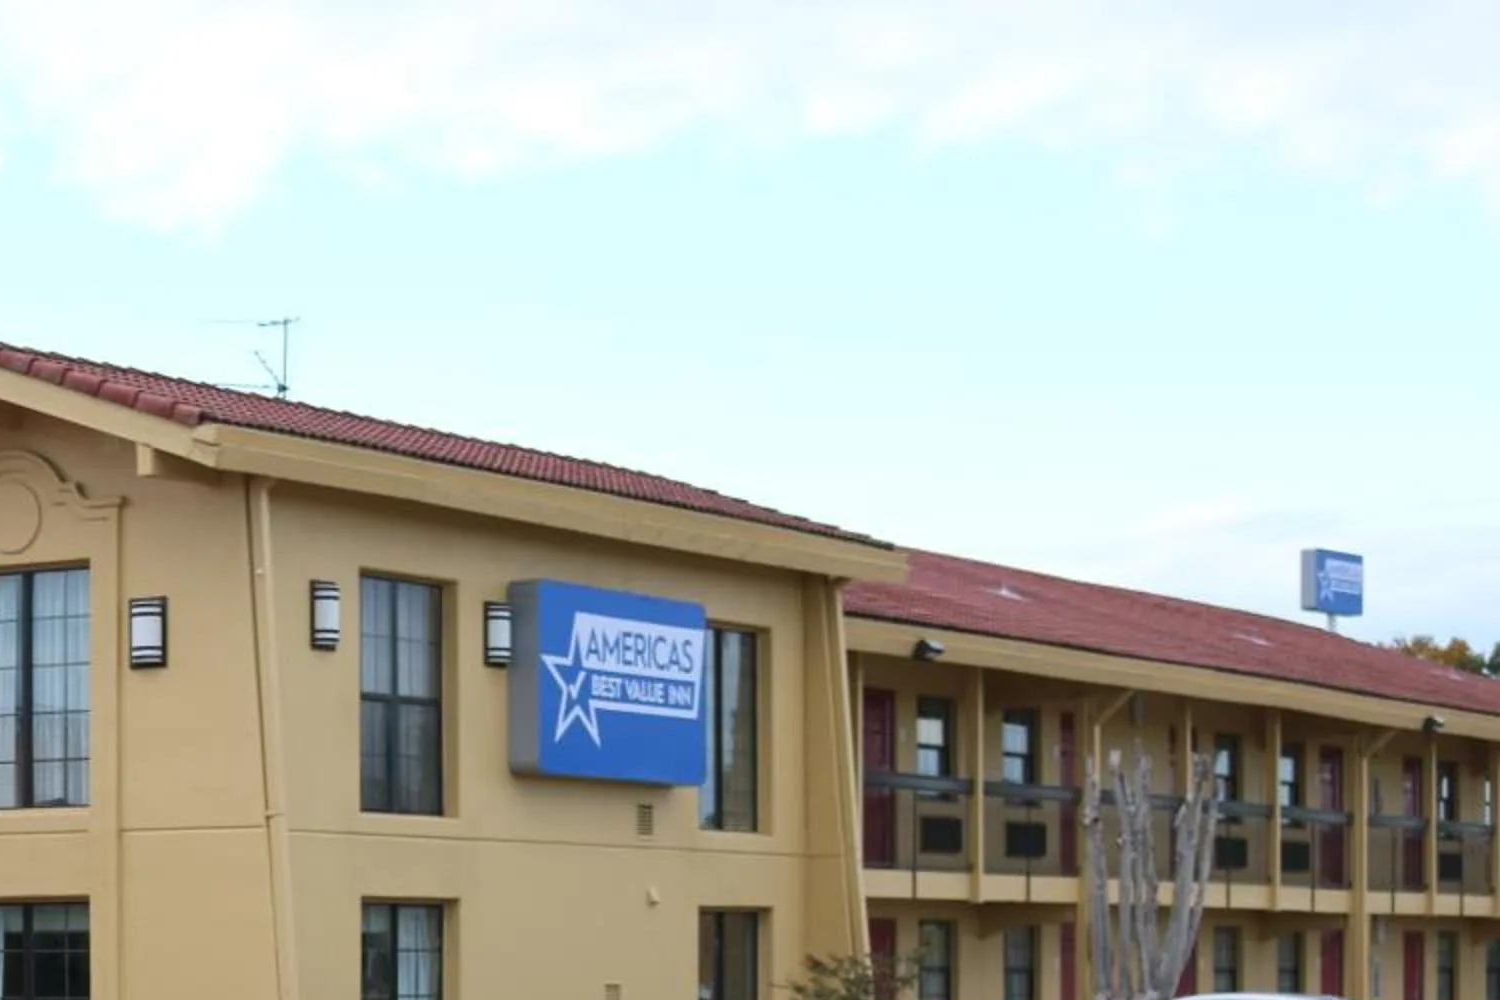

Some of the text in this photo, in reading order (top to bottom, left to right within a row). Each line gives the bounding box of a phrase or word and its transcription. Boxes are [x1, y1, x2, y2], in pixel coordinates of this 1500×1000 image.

[585, 627, 694, 674] AMERICAS
[591, 674, 693, 706] BEST VALUE INN
